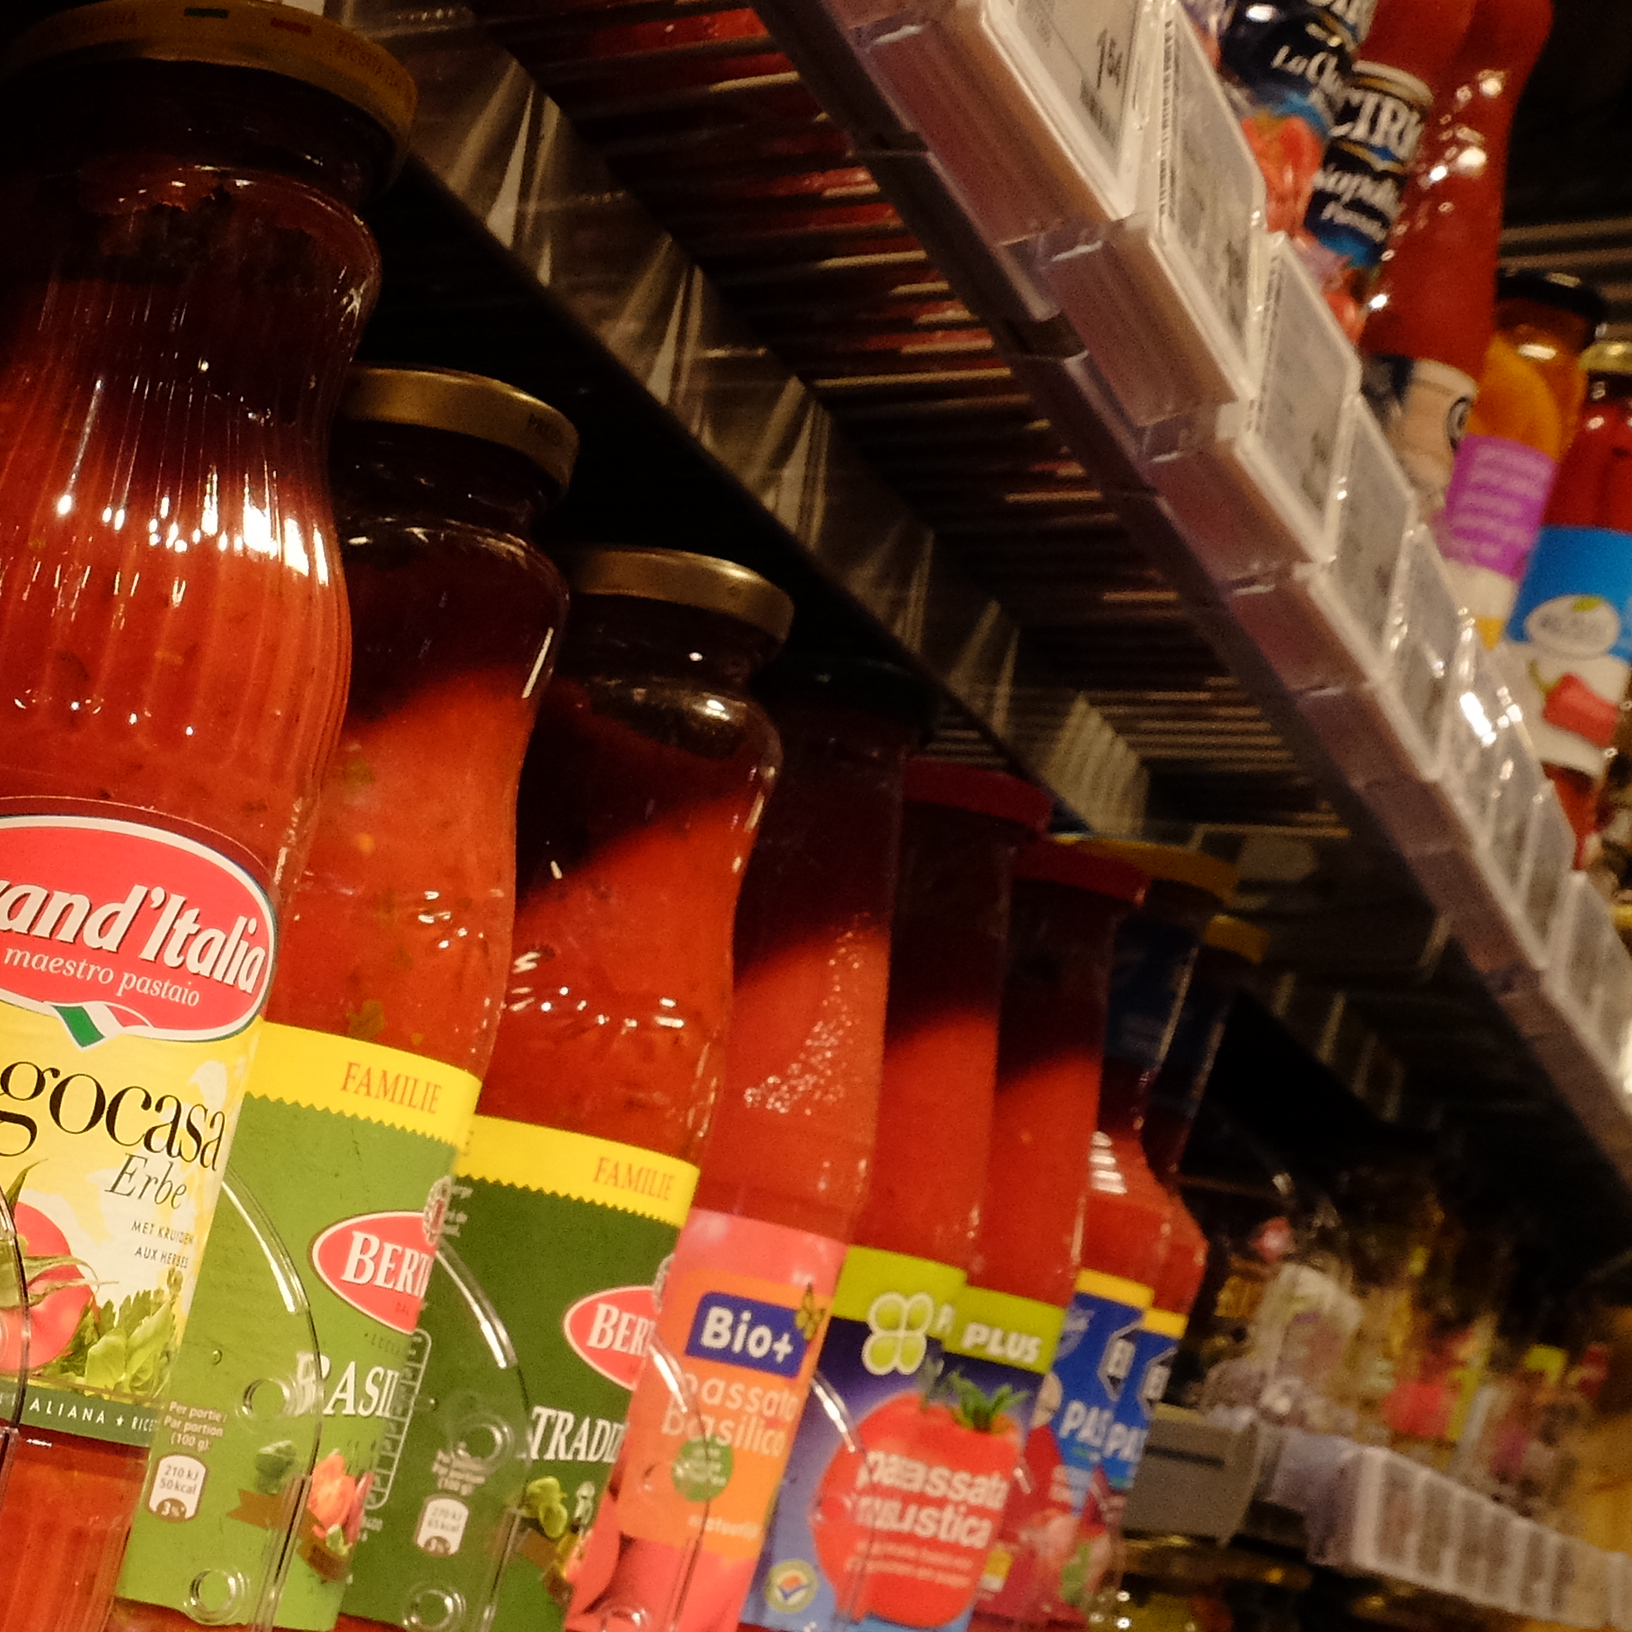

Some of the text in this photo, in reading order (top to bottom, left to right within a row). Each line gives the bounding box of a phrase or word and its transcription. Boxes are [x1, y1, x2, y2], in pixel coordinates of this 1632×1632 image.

[3, 944, 201, 1009] maestro pastaio
[340, 1060, 443, 1116] FAMILIE
[104, 1152, 189, 1210] Erbe
[593, 1156, 676, 1203] FAMILIE
[131, 1218, 154, 1236] MET
[133, 1244, 157, 1262] AUX
[699, 1304, 795, 1366] Bio+
